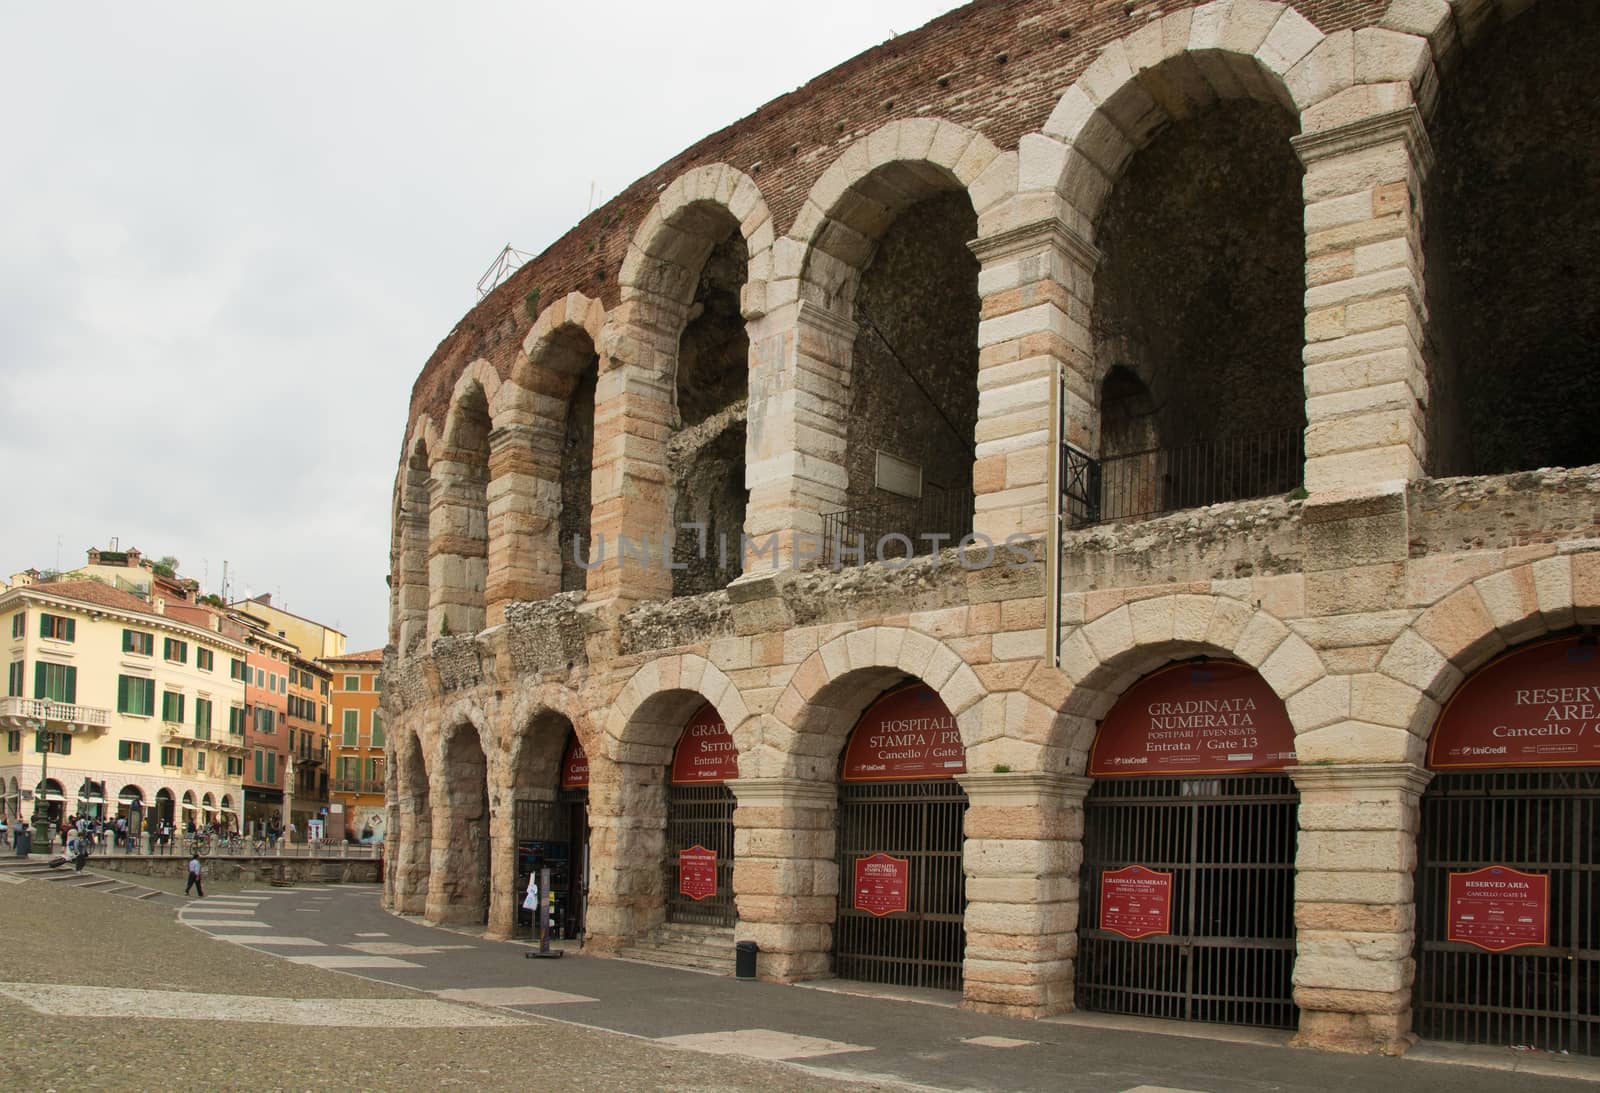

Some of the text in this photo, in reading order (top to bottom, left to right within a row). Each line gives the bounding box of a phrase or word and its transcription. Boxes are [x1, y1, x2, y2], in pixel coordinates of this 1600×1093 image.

[1148, 698, 1256, 715] GRADINATA
[1151, 713, 1253, 729] NUMERATA
[1492, 724, 1571, 738] Cancello
[870, 734, 925, 748] STAMPA
[1146, 741, 1191, 751] Entrata
[1207, 740, 1238, 750] Gate
[1242, 738, 1258, 748] 13
[878, 750, 921, 759] Cancello
[933, 747, 958, 757] Gate
